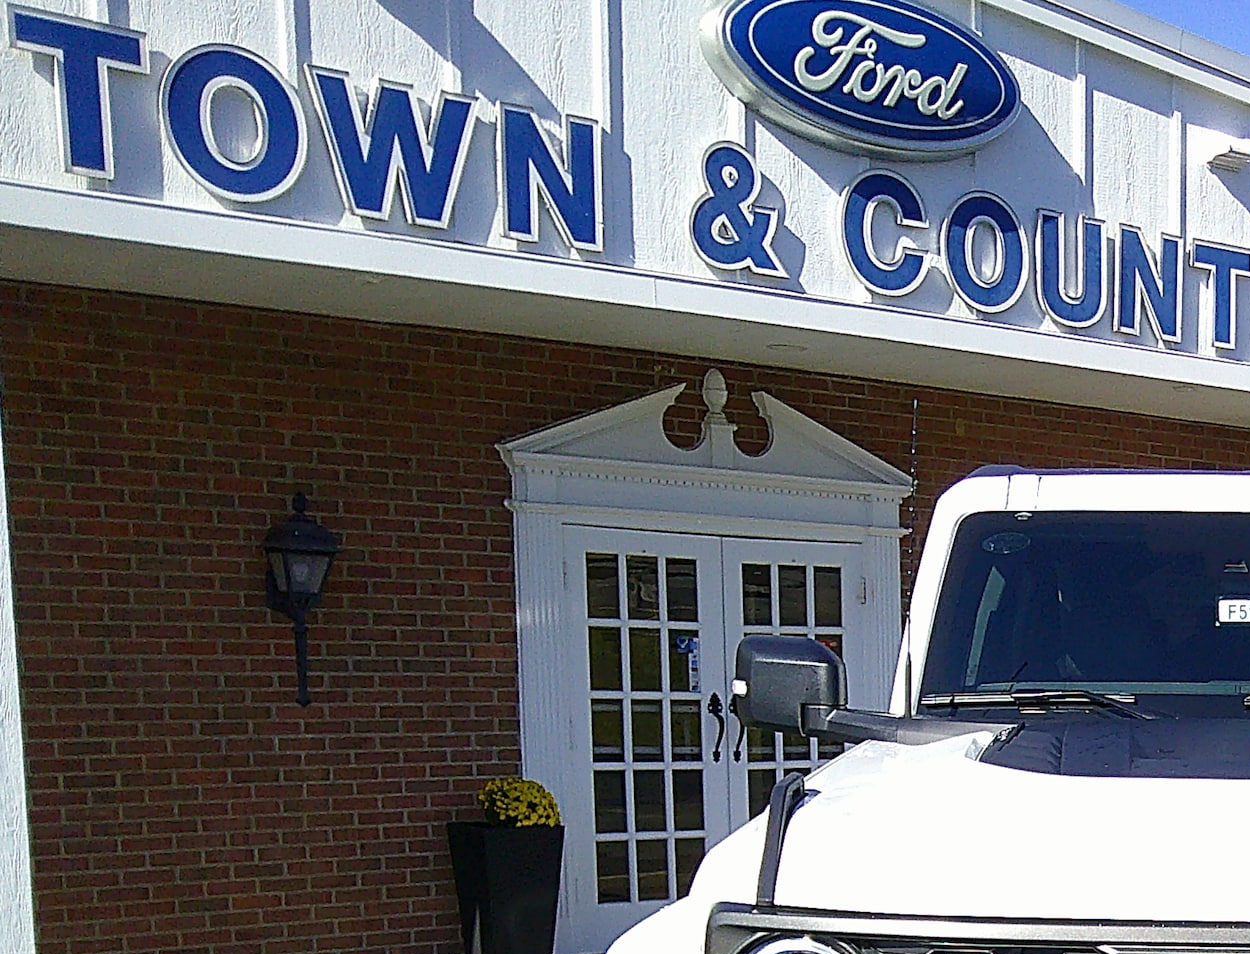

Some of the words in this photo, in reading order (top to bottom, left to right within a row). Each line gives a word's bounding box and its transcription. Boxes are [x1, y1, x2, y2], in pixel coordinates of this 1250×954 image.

[7, 5, 604, 252] TOWN
[690, 140, 790, 278] &
[794, 10, 968, 120] Ford
